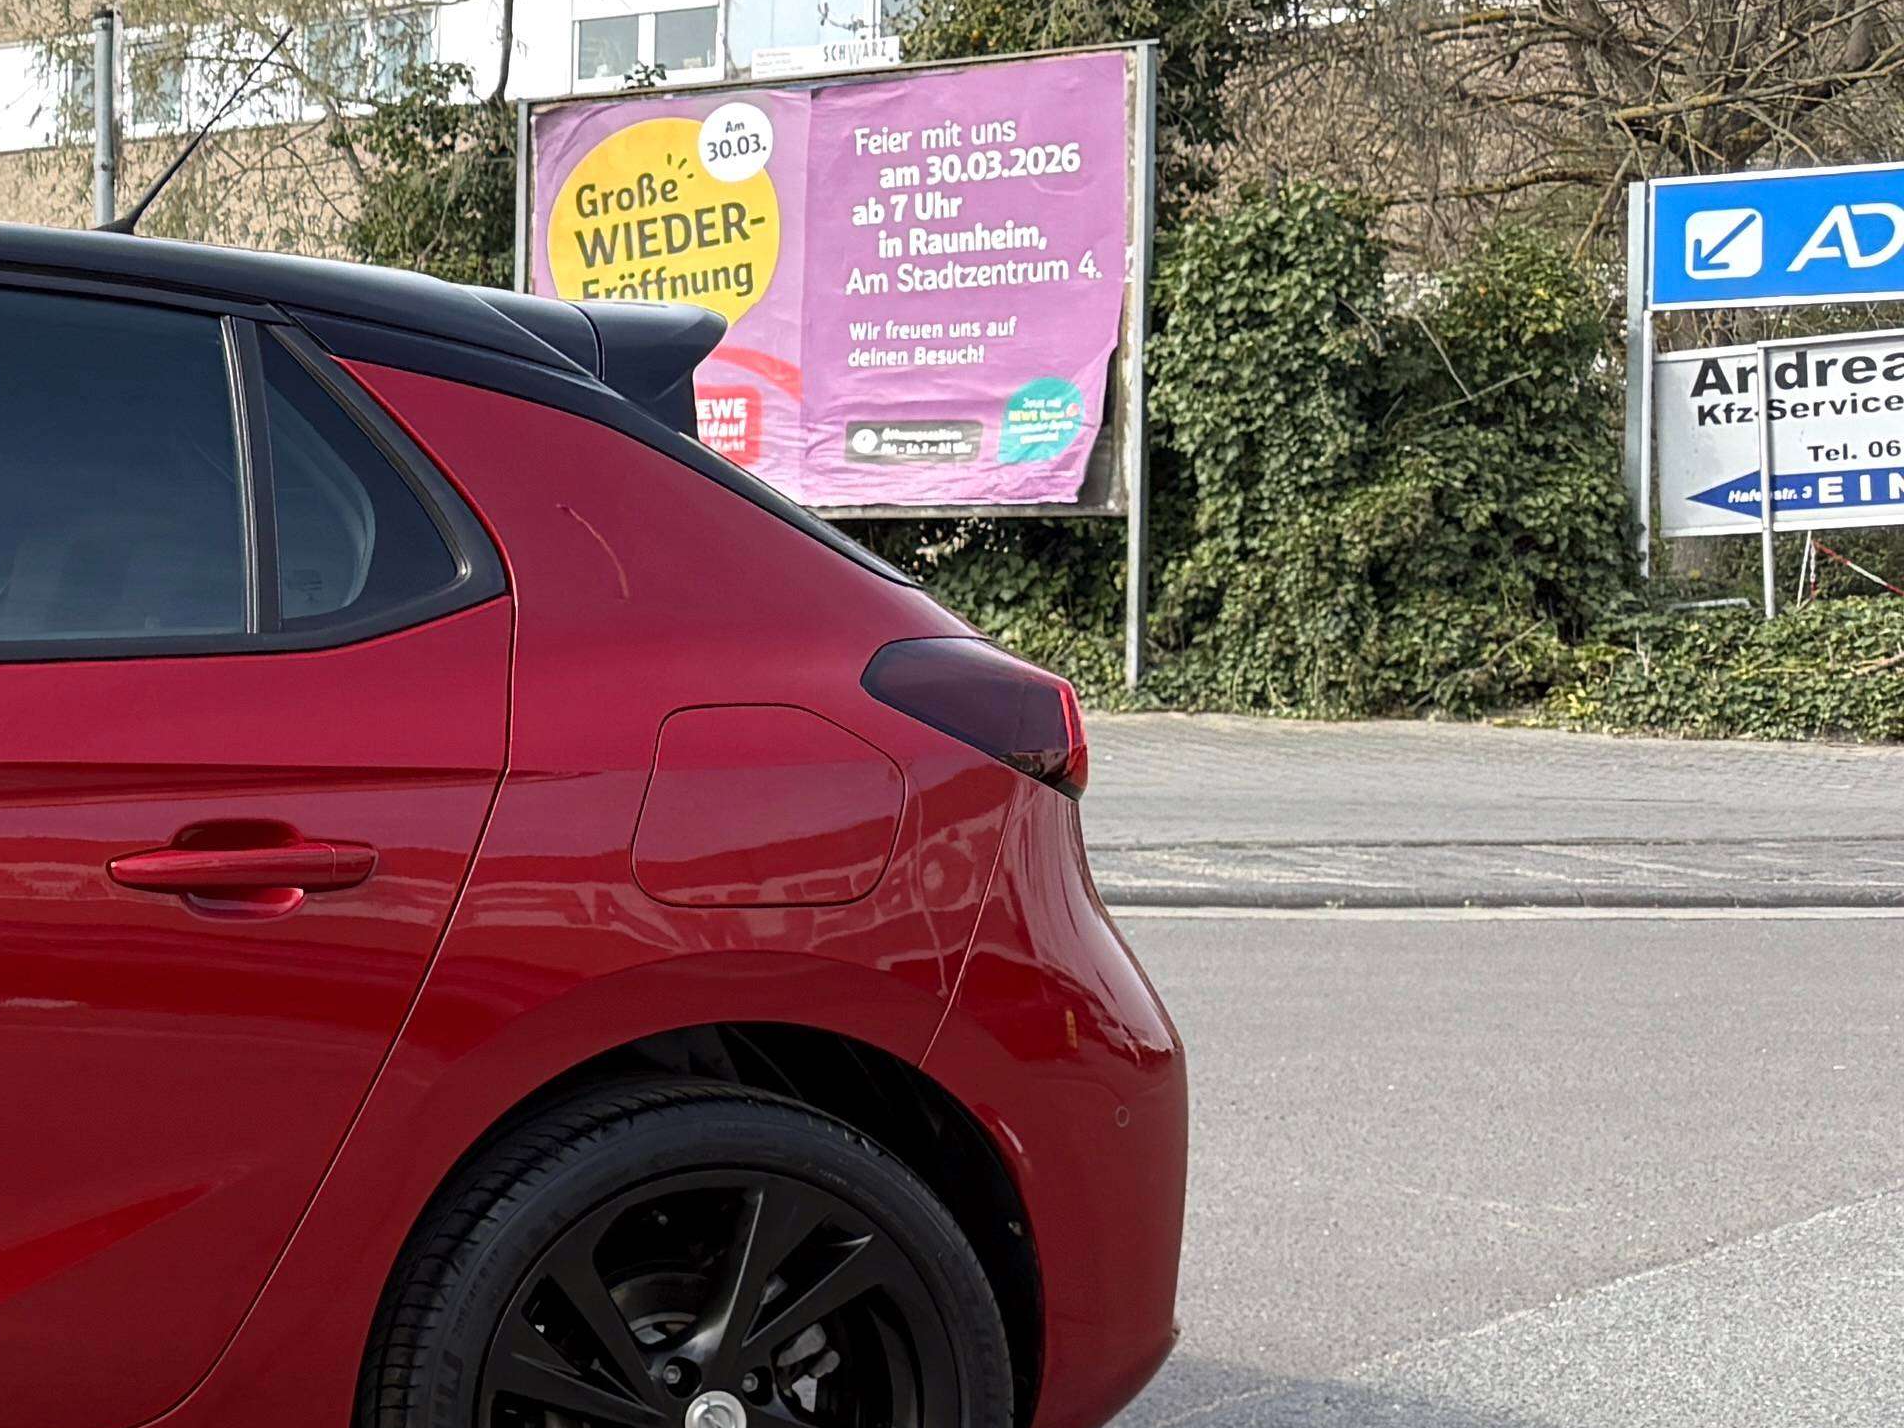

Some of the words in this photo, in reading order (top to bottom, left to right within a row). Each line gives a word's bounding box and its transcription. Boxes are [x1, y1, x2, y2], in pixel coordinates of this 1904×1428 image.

[823, 40, 886, 66] SCHWARZ
[725, 120, 745, 133] Am
[854, 125, 912, 156] Feier
[922, 119, 962, 149] mit
[971, 120, 1017, 145] uns
[706, 133, 767, 162] 30.03.
[879, 165, 920, 188] am
[926, 142, 1081, 185] 30.03.2026
[575, 172, 679, 219] Große
[852, 196, 885, 226] ab
[890, 193, 909, 222] 7
[914, 191, 963, 220] Uhr
[574, 202, 766, 269] WIEDER-
[878, 230, 903, 258] in
[909, 220, 1047, 256] Raunheim,
[1785, 202, 1904, 272] AD
[582, 262, 754, 300] Eröffnung
[845, 267, 889, 295] Am
[896, 260, 1069, 292] Stadtzentrum
[1078, 250, 1103, 279] 4.
[848, 322, 881, 341] Wir
[885, 320, 943, 340] freuen
[948, 322, 982, 338] uns
[986, 315, 1018, 337] auf
[848, 347, 909, 367] deinen
[913, 344, 985, 366] Besuch!
[1807, 443, 1857, 462] Tel.
[1868, 439, 1903, 458] 06
[1802, 485, 1812, 499] 3
